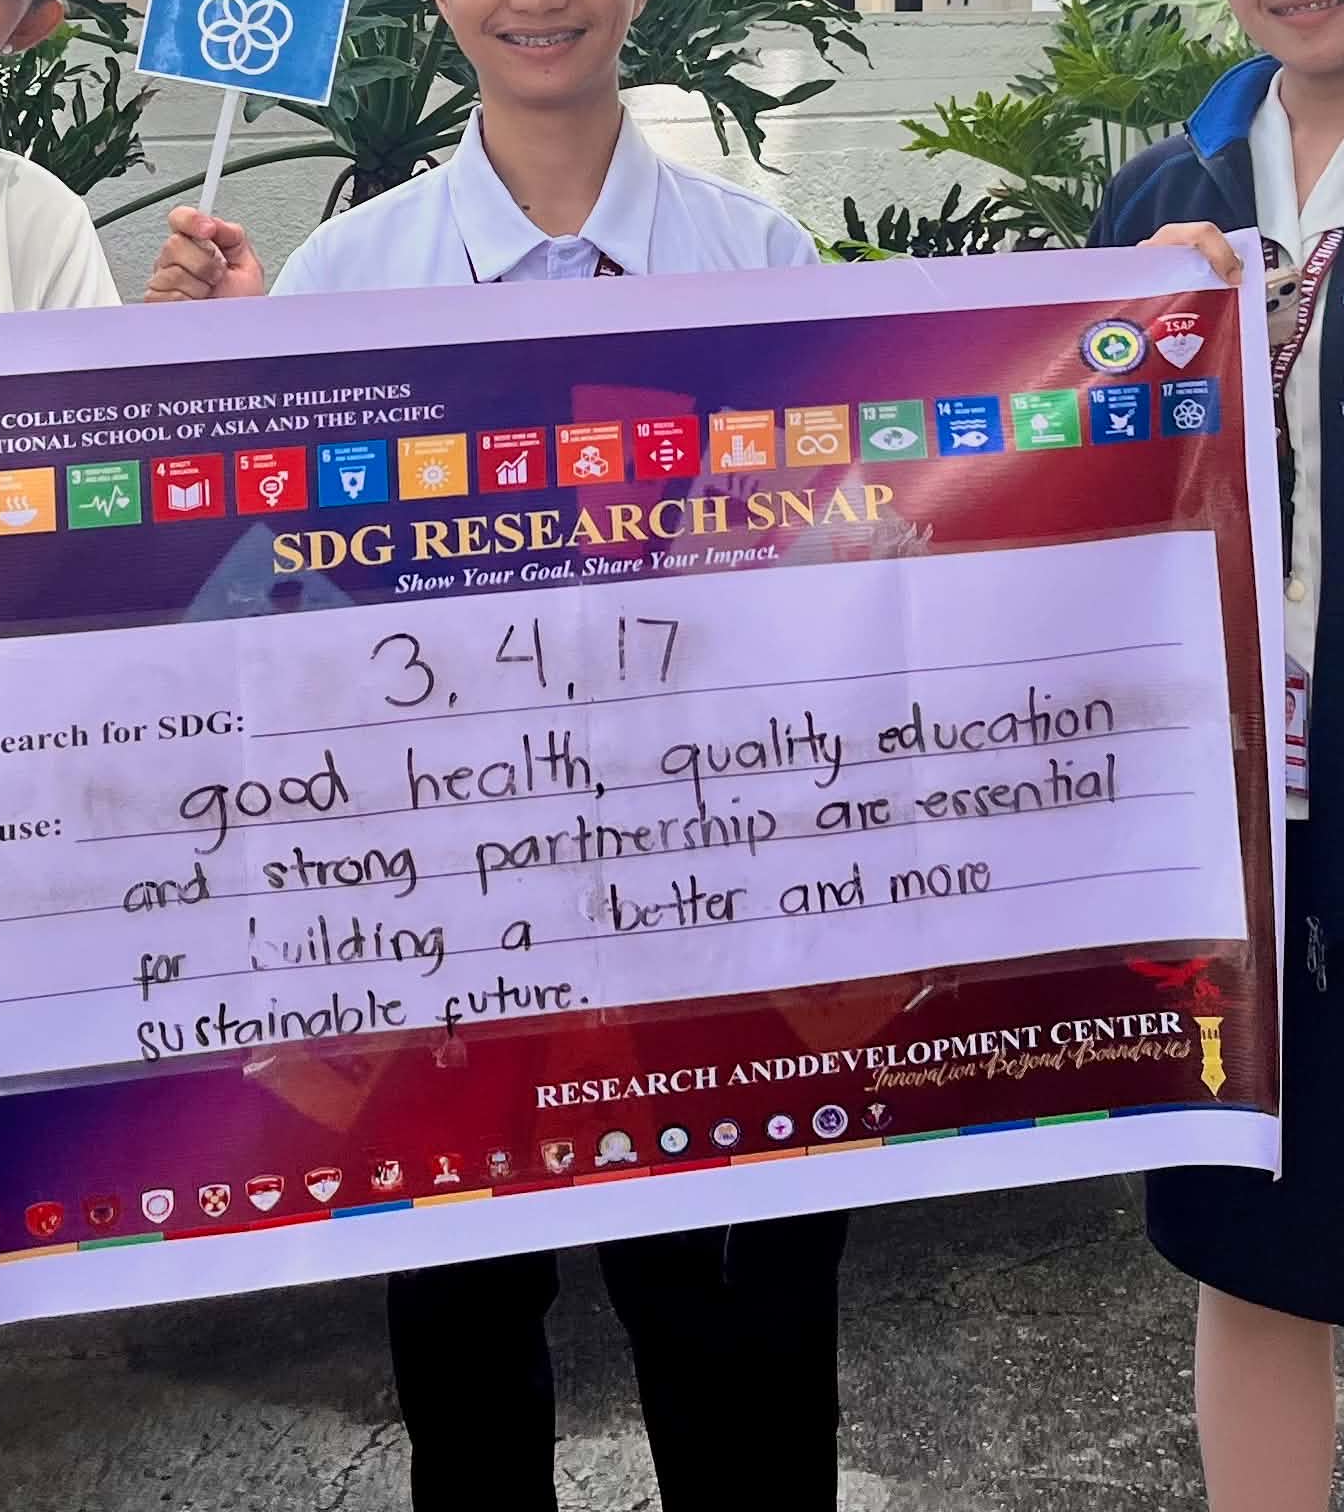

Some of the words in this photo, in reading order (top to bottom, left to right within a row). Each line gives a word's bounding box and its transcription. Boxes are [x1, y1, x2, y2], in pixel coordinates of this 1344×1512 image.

[1090, 390, 1105, 404] 16
[1162, 383, 1174, 397] 17
[0, 405, 118, 431] COLLEGES
[123, 402, 152, 420] OF
[157, 393, 277, 419] NORTHERN
[282, 382, 412, 409] PHILIPPINES
[936, 401, 952, 417] 14
[1014, 395, 1028, 410] 15
[862, 406, 877, 421] 13
[81, 426, 173, 451] SCHOOL
[177, 422, 206, 440] OF
[208, 418, 260, 438] ASIA
[264, 414, 310, 433] AND
[313, 410, 357, 429] THE
[360, 403, 446, 425] PACIFIC
[636, 423, 650, 437] 10
[712, 418, 725, 432] 11
[482, 436, 491, 450] 8
[560, 430, 570, 444] 9
[321, 449, 331, 463] 6
[402, 442, 411, 455] 7
[156, 462, 166, 477] 4
[240, 455, 250, 469] 5
[71, 470, 81, 485] 3
[271, 525, 395, 575] SDG
[411, 496, 729, 560] RESEARCH
[746, 483, 895, 532] SNAP
[394, 573, 456, 595] Show
[461, 565, 515, 589] Your
[519, 559, 575, 583] Goal.
[581, 554, 644, 578] Share
[649, 548, 700, 571] Your
[704, 542, 780, 567] Impact.
[617, 613, 680, 683] 17
[102, 720, 148, 747] for
[157, 711, 245, 741] SDG:
[179, 748, 350, 856] good
[407, 730, 605, 810] health,
[660, 709, 845, 808] quality
[877, 684, 1115, 753] education
[123, 860, 212, 914] and
[262, 845, 418, 899] strong
[475, 796, 777, 895] partnership
[814, 793, 892, 834] are
[915, 752, 1117, 821] essential
[500, 919, 531, 951] a
[609, 875, 748, 932] better
[779, 860, 864, 914] and
[889, 859, 991, 898] more
[136, 990, 407, 1061] sustainable
[442, 975, 589, 1031] future.
[536, 1065, 719, 1109] RESEARCH
[727, 1025, 1042, 1087] ANDDEVELOPMENT
[1050, 1009, 1184, 1044] CENTER
[864, 1059, 977, 1092] Innovation
[979, 1047, 1065, 1080] Beyond
